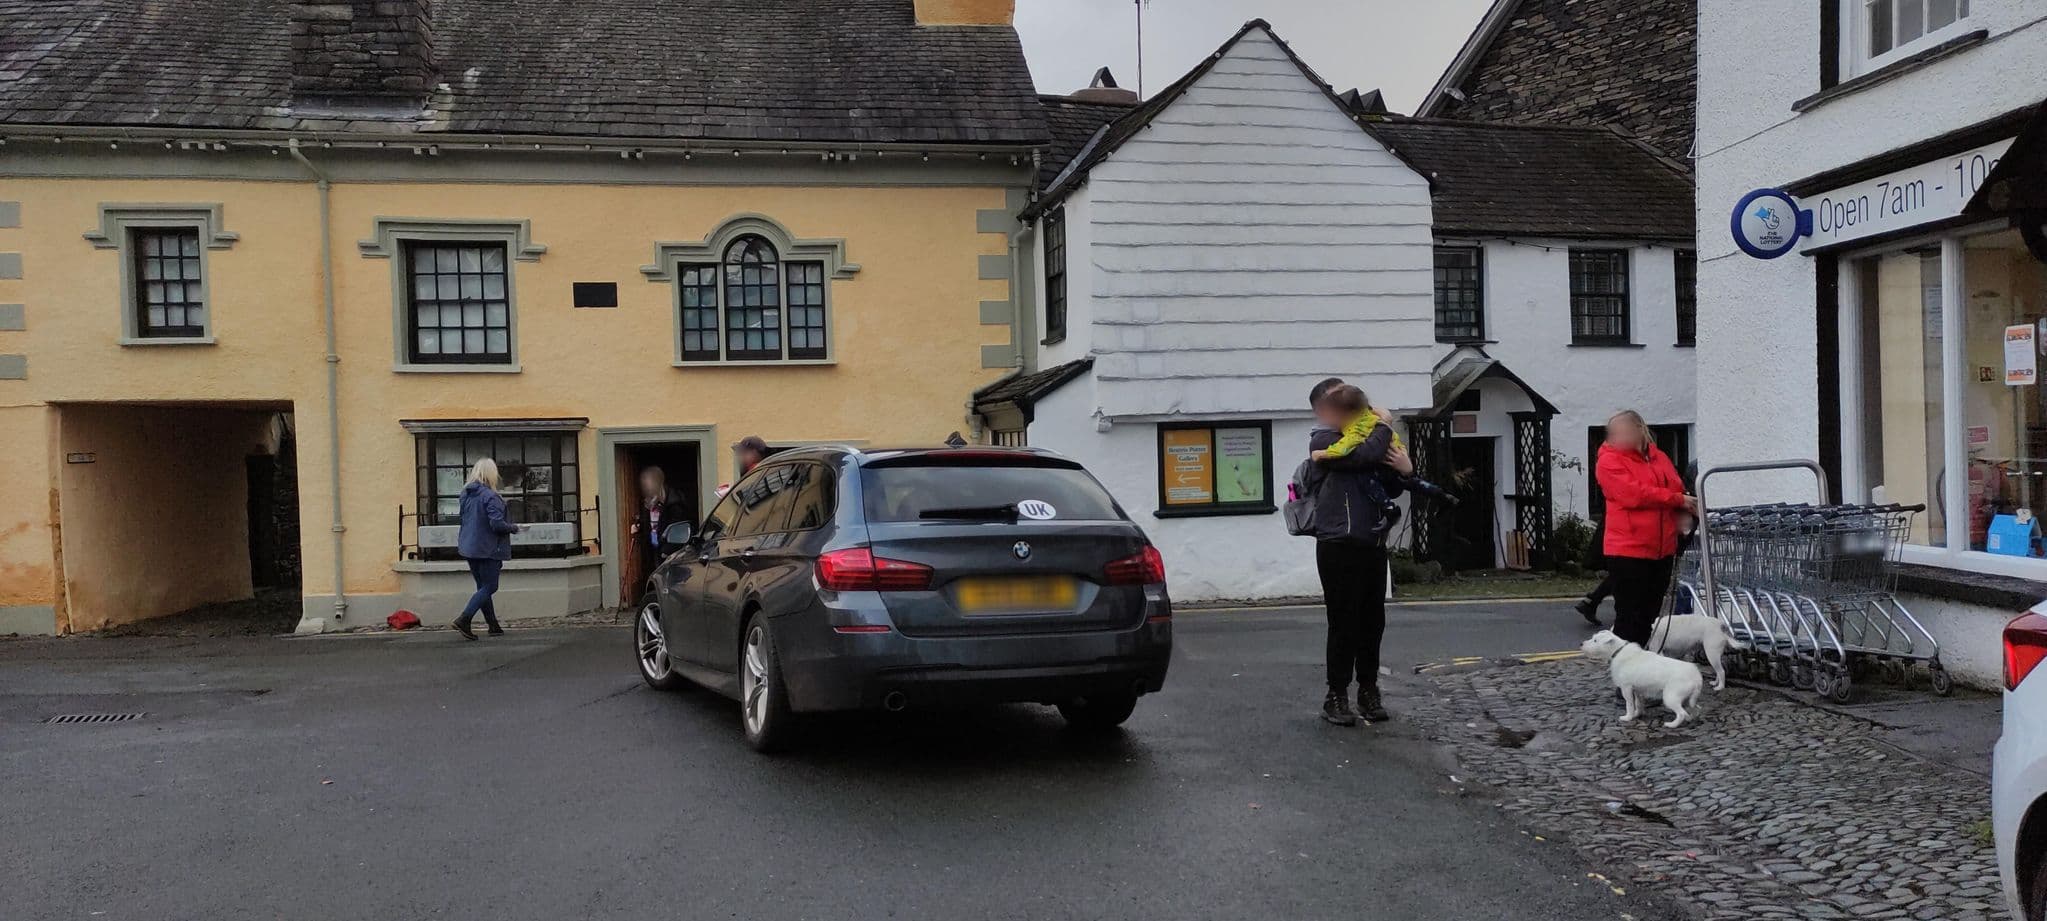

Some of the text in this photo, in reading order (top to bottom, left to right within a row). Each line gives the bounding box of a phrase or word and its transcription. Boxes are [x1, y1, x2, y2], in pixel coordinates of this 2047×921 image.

[1820, 195, 1869, 238] Open
[1877, 180, 1925, 219] 7am
[1024, 503, 1050, 516] UK
